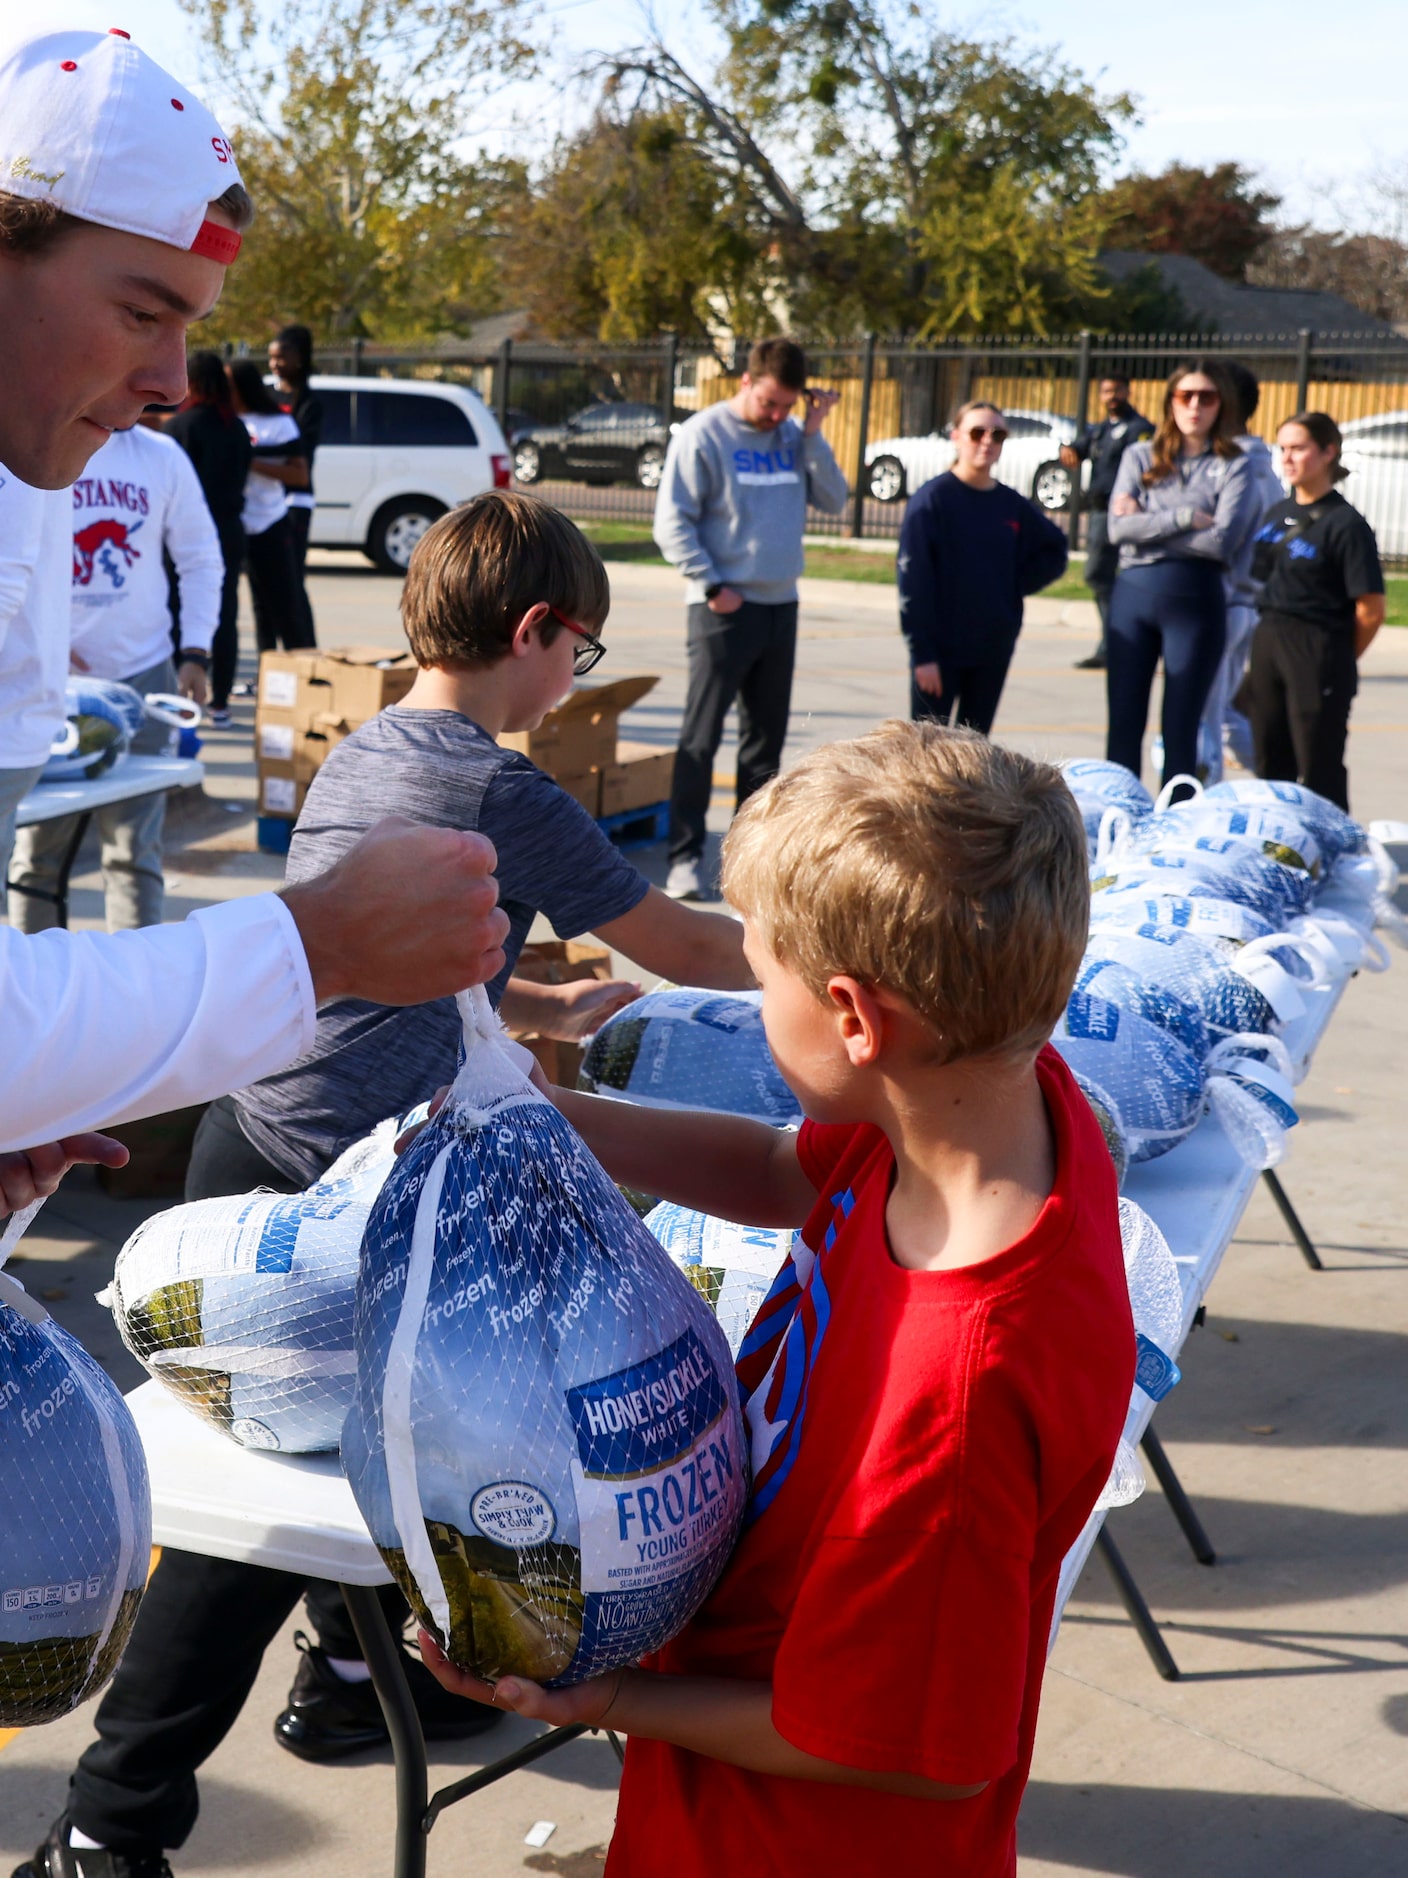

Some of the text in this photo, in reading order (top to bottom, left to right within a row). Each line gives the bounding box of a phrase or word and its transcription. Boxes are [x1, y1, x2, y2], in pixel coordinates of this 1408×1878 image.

[734, 448, 796, 474] SMU
[72, 477, 151, 517] STANGS
[445, 1244, 476, 1273] frozen
[423, 1272, 496, 1333] frozen
[489, 1278, 547, 1337] frozen
[551, 1261, 599, 1341] frozen
[25, 1346, 54, 1378] frozen
[21, 1369, 81, 1438] frozen
[583, 1345, 712, 1437] HONEYSUCKLE
[641, 1408, 689, 1447] WHITE
[615, 1433, 734, 1541] FROZEN
[636, 1492, 730, 1563] YOUNG TURKEY
[607, 1569, 633, 1579] BASTED
[634, 1564, 651, 1576] WITH
[619, 1578, 642, 1590] SUGAR
[642, 1576, 656, 1586] AND
[5, 1597, 19, 1608] 150
